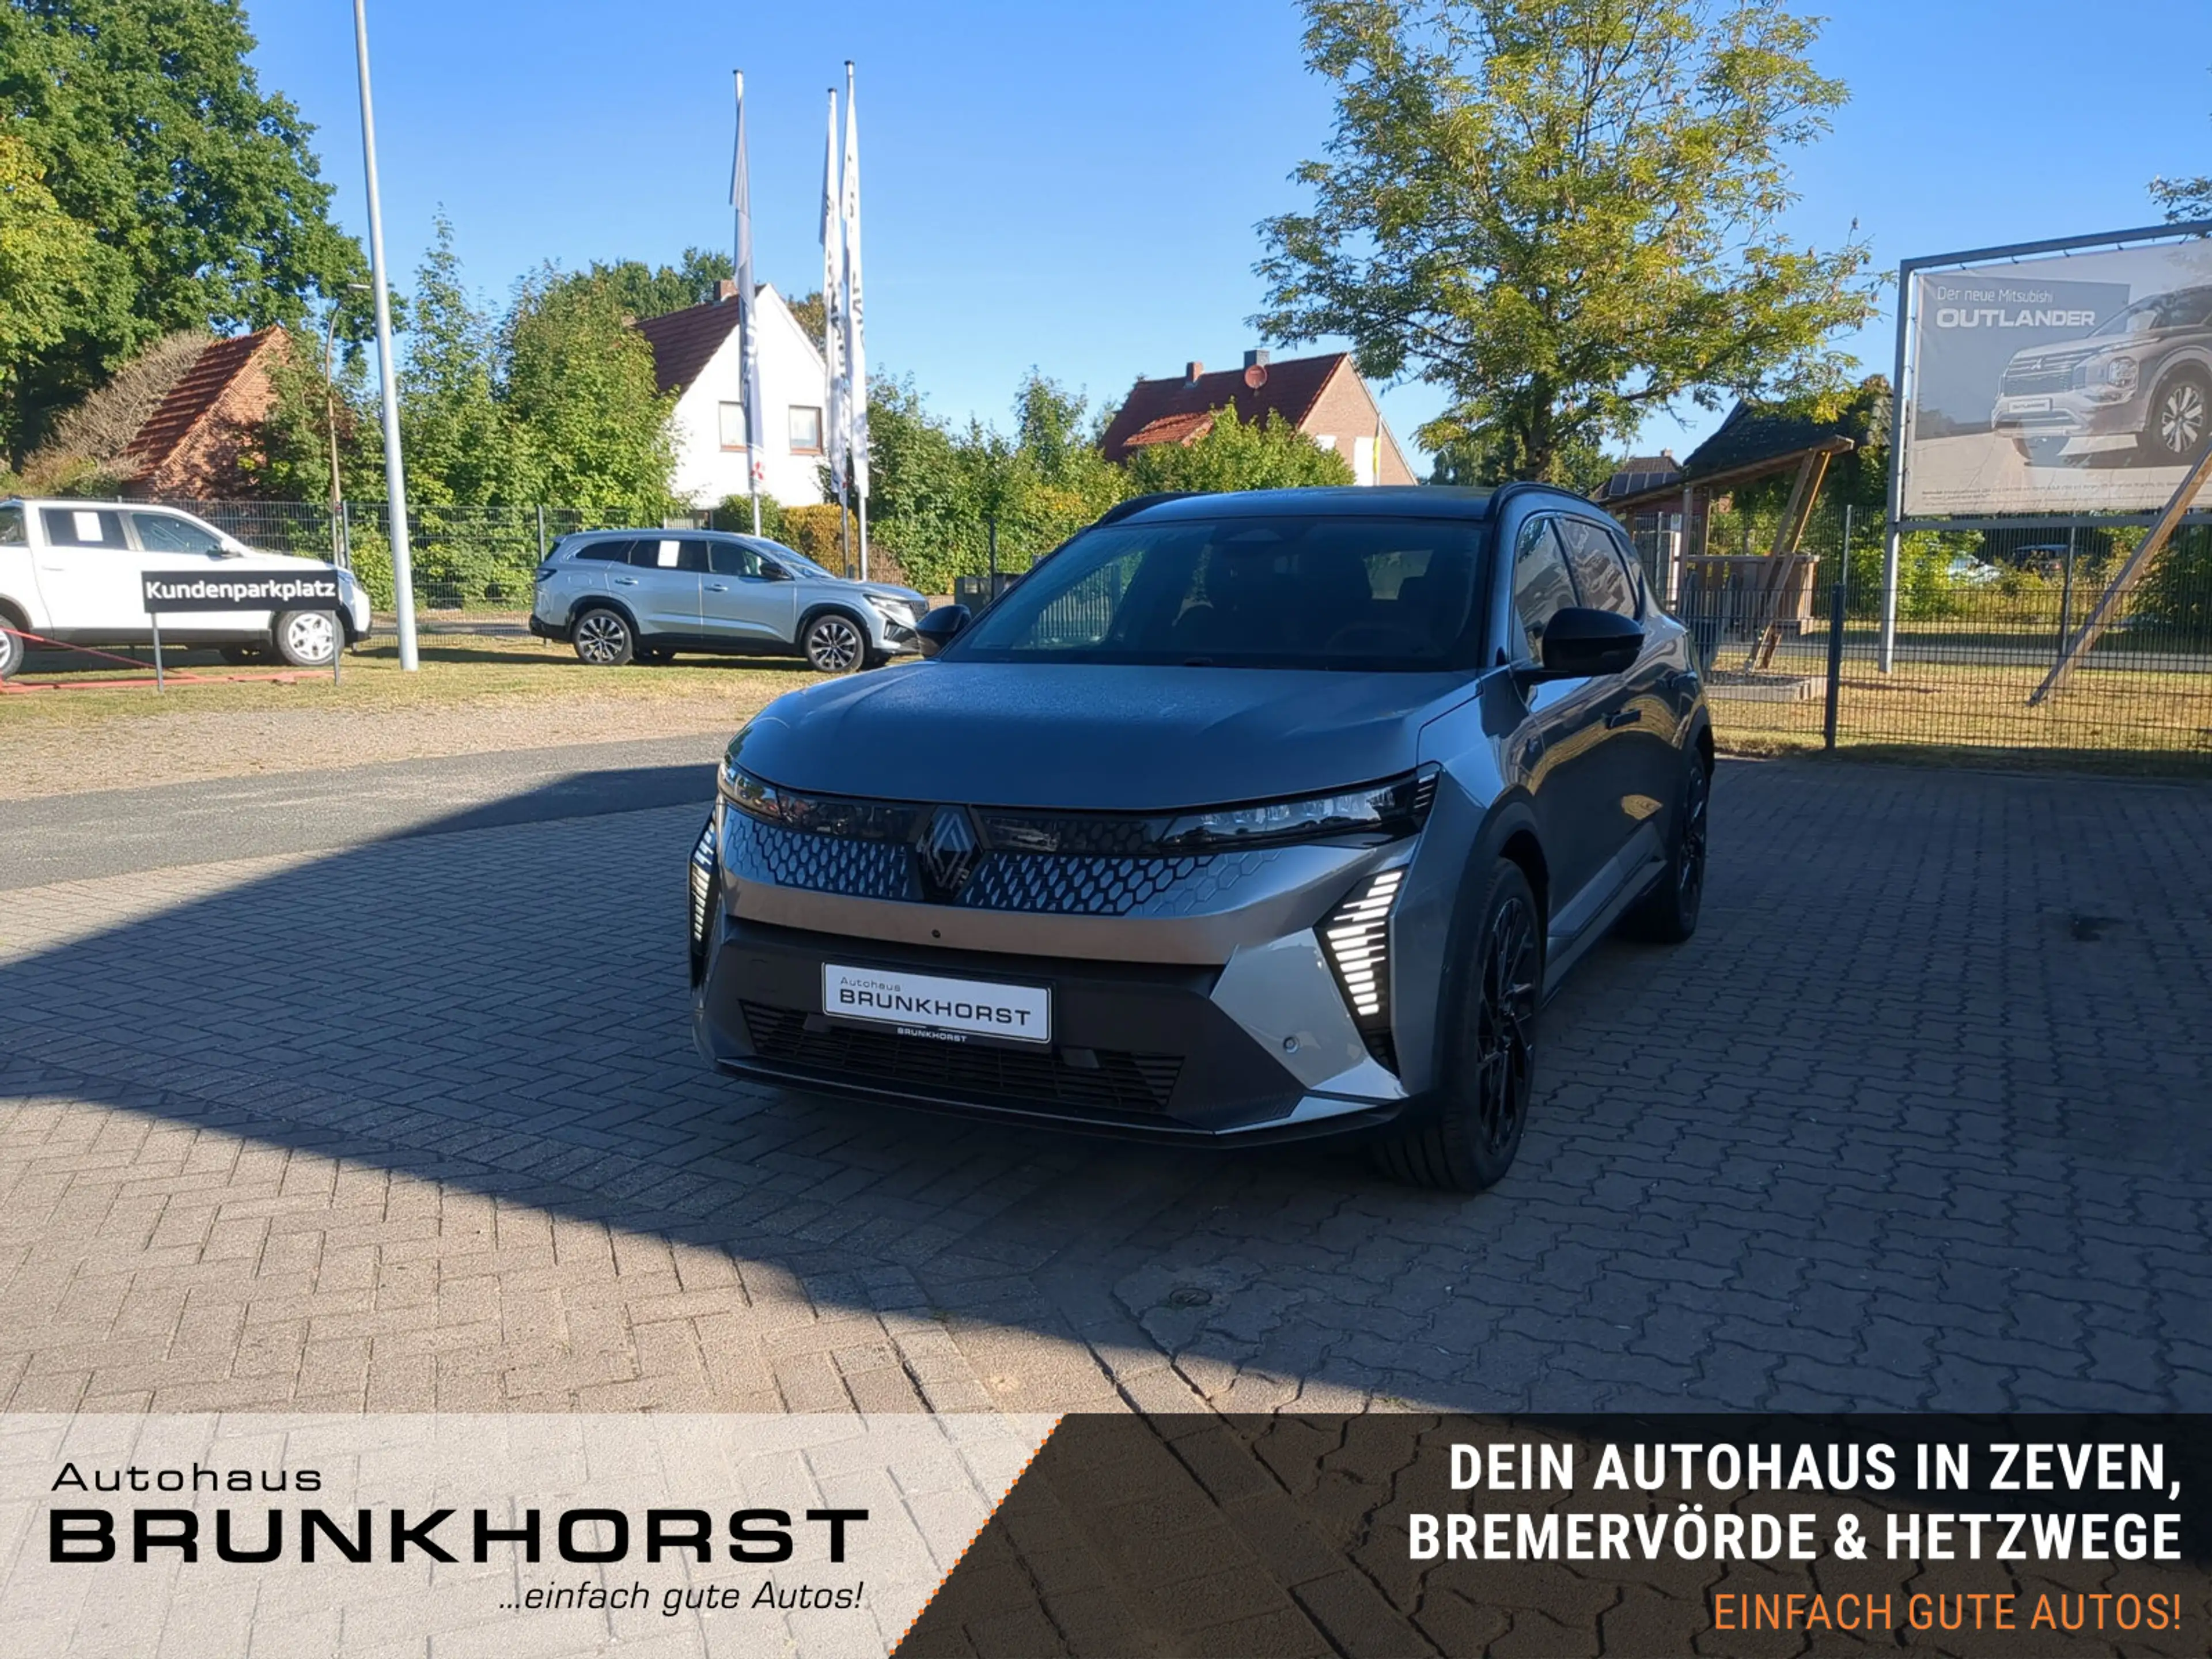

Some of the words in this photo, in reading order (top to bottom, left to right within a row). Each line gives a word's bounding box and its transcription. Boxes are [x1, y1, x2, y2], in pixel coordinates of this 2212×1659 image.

[1938, 286, 1960, 300] Der
[1964, 289, 1995, 302] neue
[1999, 289, 2053, 303] Mitsubishi
[1936, 308, 2096, 328] OUTLANDER
[146, 579, 336, 602] Kundenparkplatz
[840, 976, 901, 992] Autohaus
[840, 988, 1031, 1026] BRUNKHORST
[897, 1027, 968, 1043] BRUNKHORST
